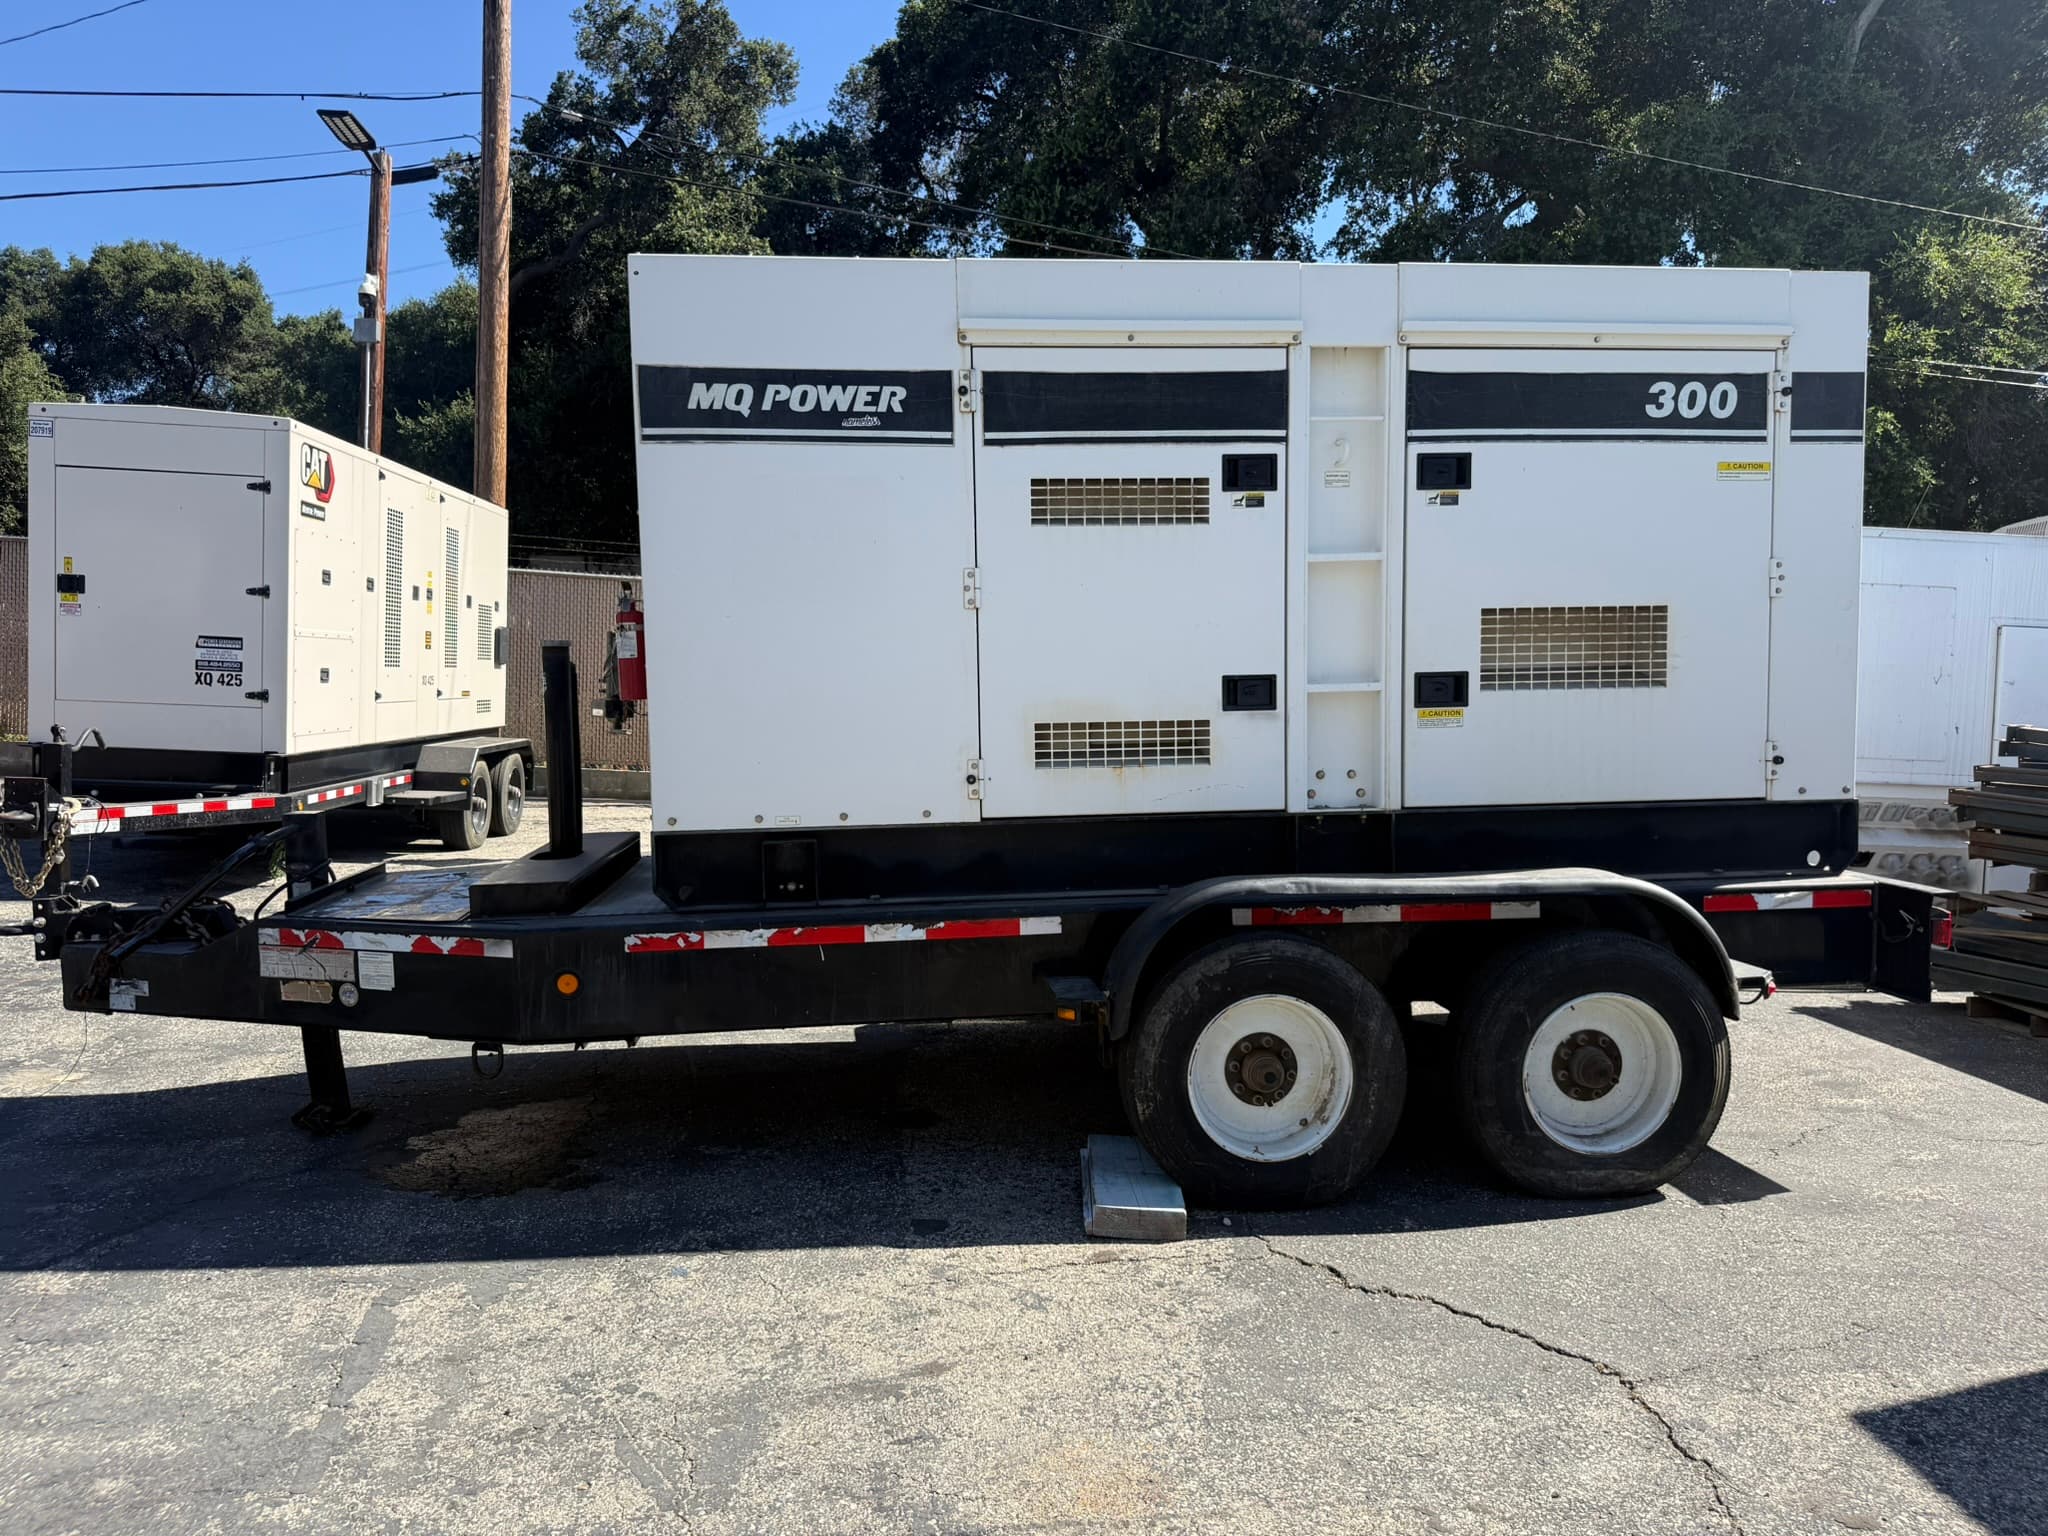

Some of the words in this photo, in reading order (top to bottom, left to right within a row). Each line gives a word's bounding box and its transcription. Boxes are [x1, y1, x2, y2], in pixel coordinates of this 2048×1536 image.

[687, 382, 754, 418] MQ
[761, 384, 907, 413] POWER
[1645, 381, 1738, 419] 300
[31, 427, 52, 435] 207919
[301, 443, 329, 491] CAT
[195, 672, 213, 687] XQ
[217, 673, 242, 687] 425
